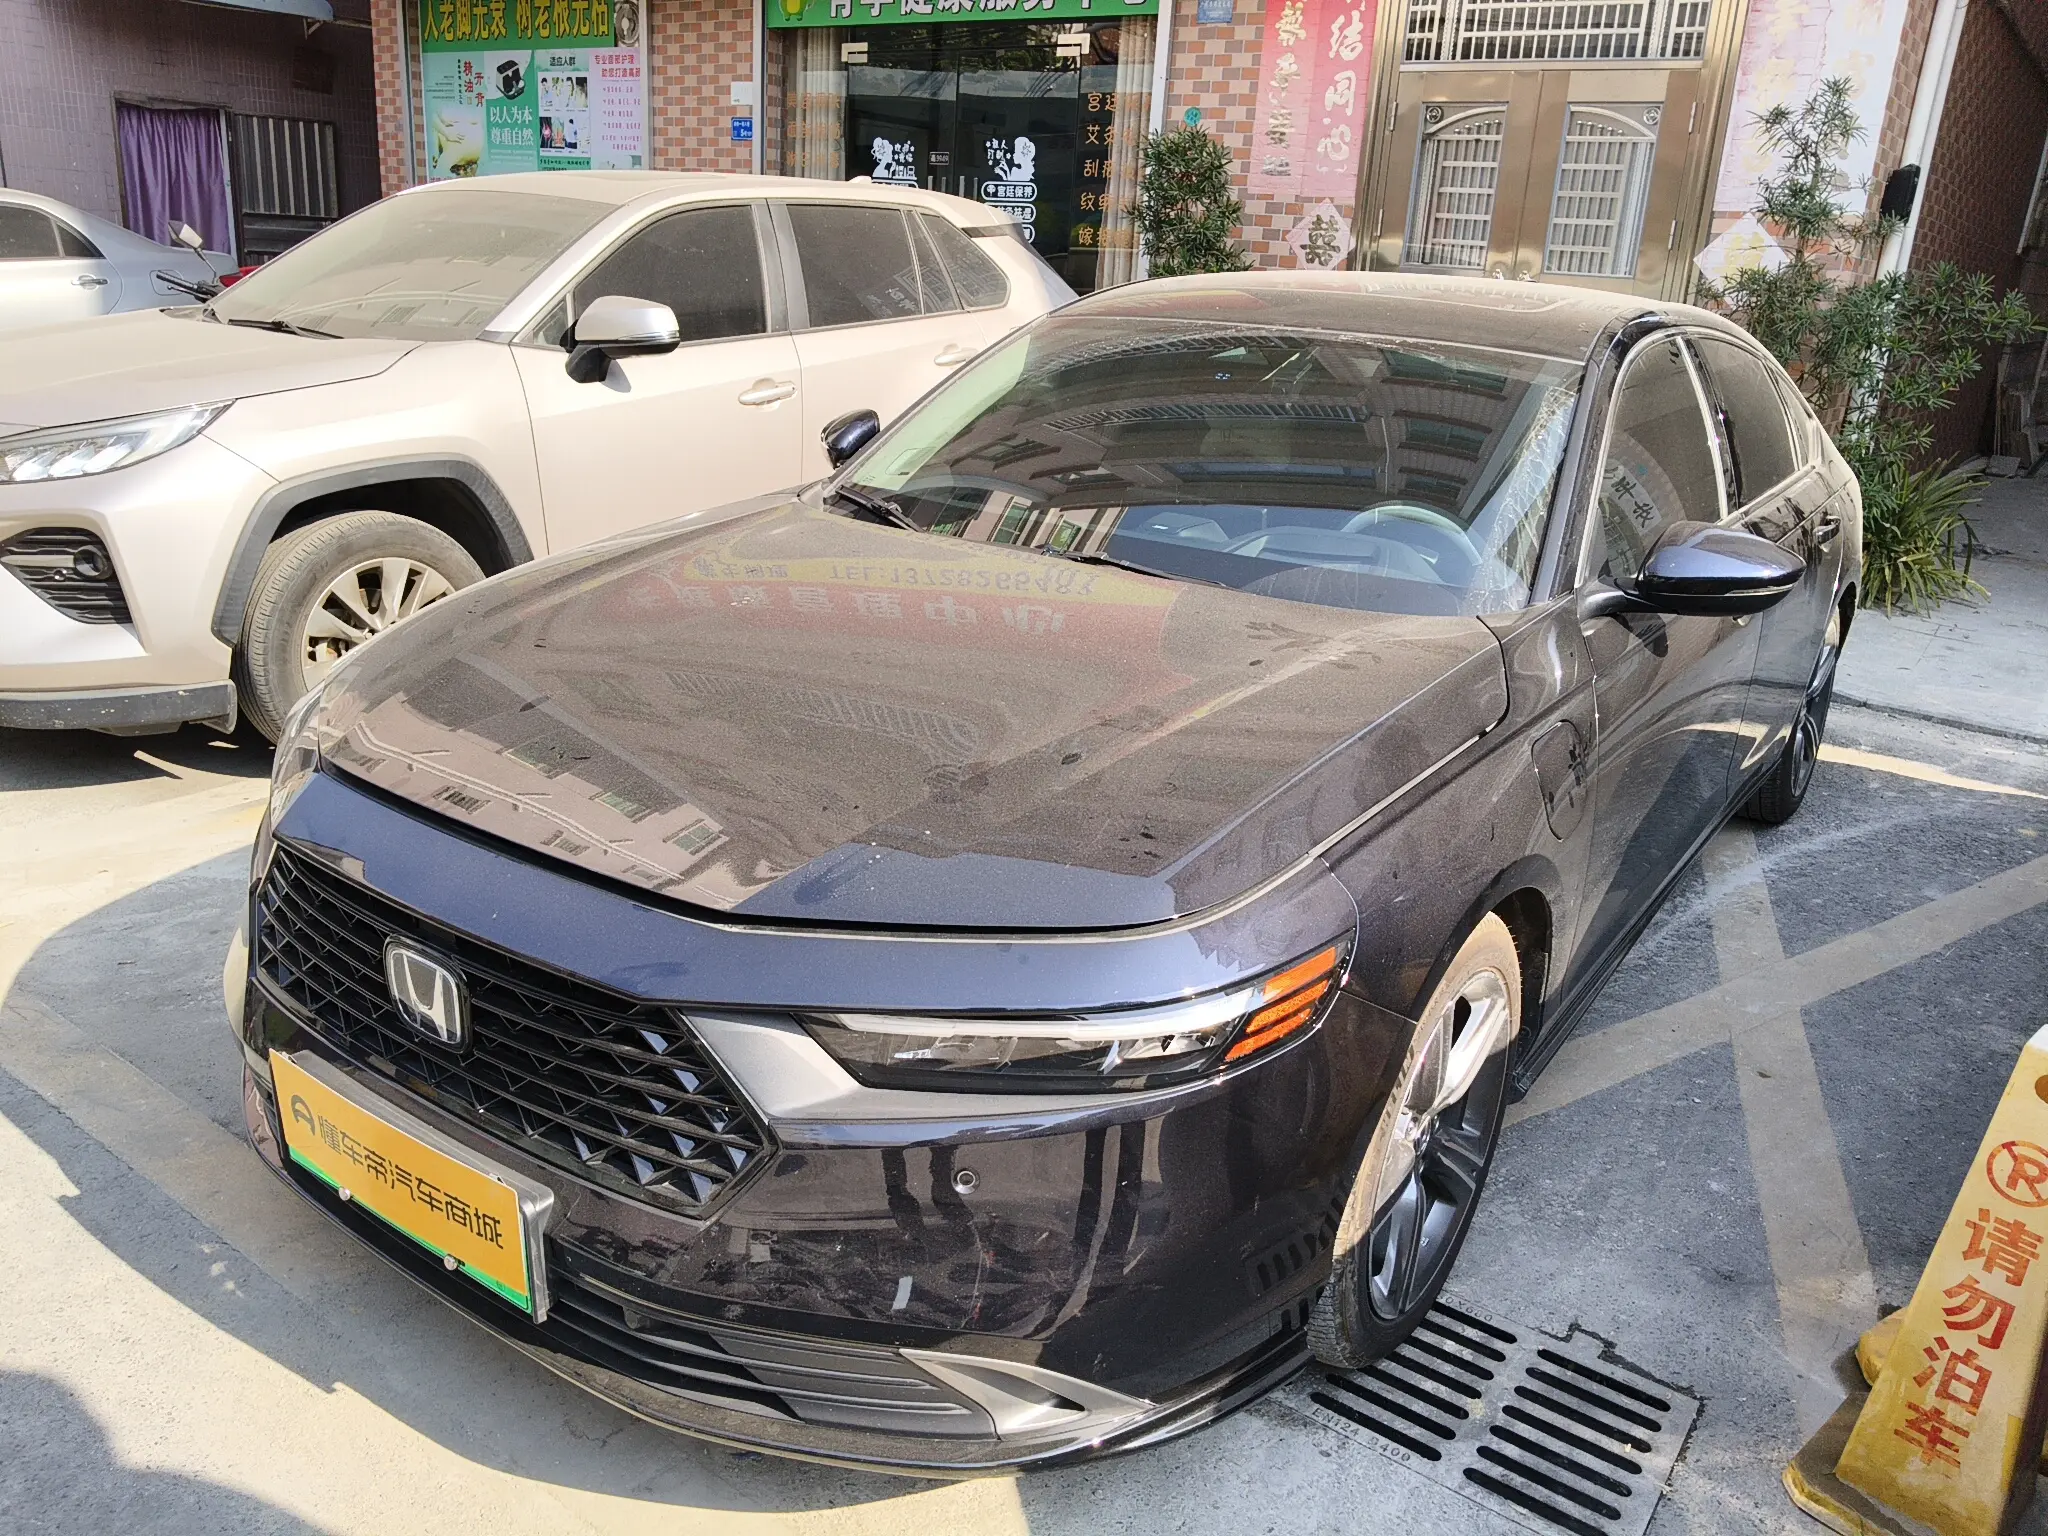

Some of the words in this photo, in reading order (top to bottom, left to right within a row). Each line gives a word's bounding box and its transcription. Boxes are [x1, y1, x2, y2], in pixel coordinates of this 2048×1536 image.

[549, 56, 576, 67] 适应人群
[490, 106, 533, 124] 以人为本
[491, 127, 534, 146] 尊重自然
[997, 185, 1033, 198] 宫廷保养
[316, 1114, 504, 1251] 懂车帝汽车商城
[1894, 1207, 2044, 1469] 请勿泊车
